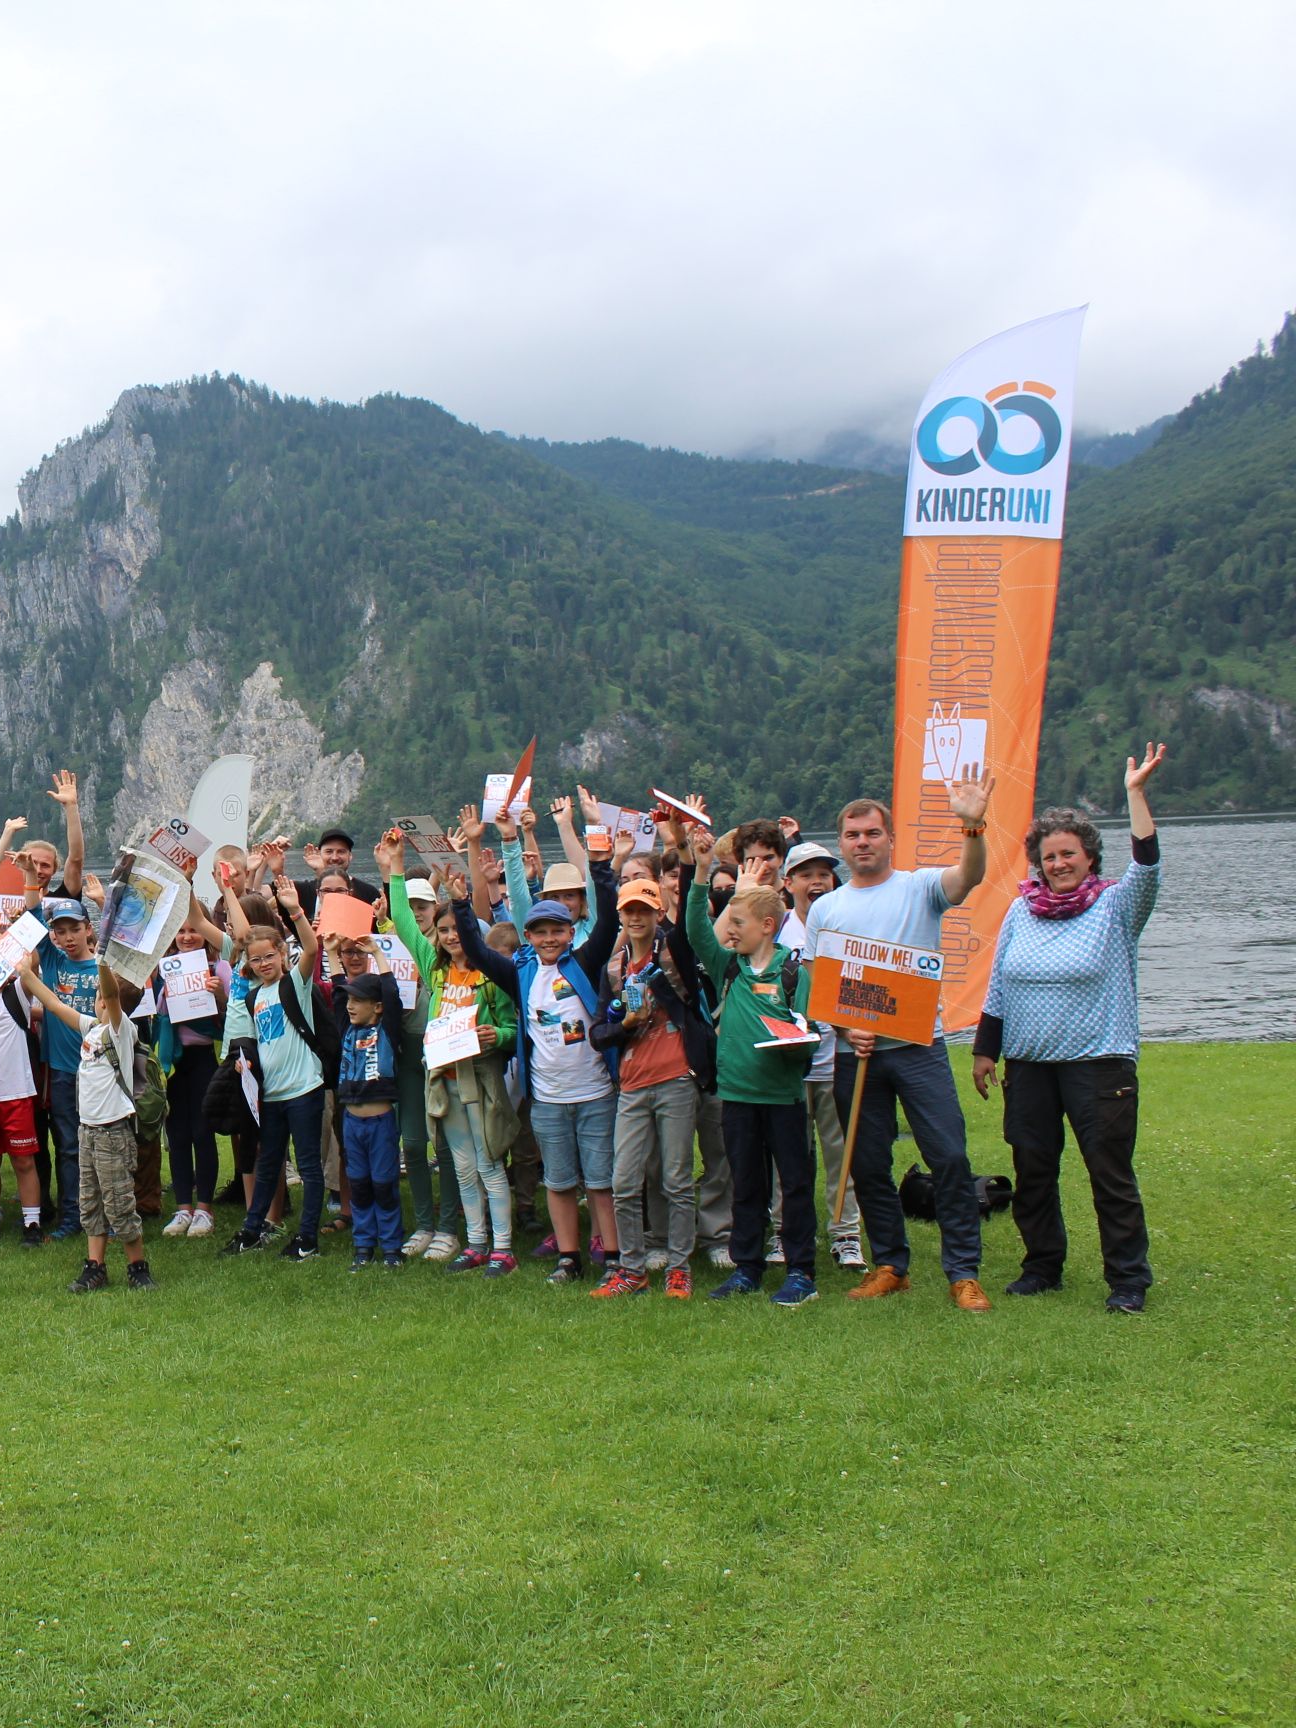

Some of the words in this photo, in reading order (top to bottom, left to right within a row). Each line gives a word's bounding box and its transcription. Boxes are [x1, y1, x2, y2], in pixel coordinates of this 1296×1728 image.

[915, 487, 1051, 524] KINDERUNI
[917, 542, 1002, 710] wissenwollen
[844, 939, 888, 963] FOLLOW
[891, 949, 913, 968] ME!
